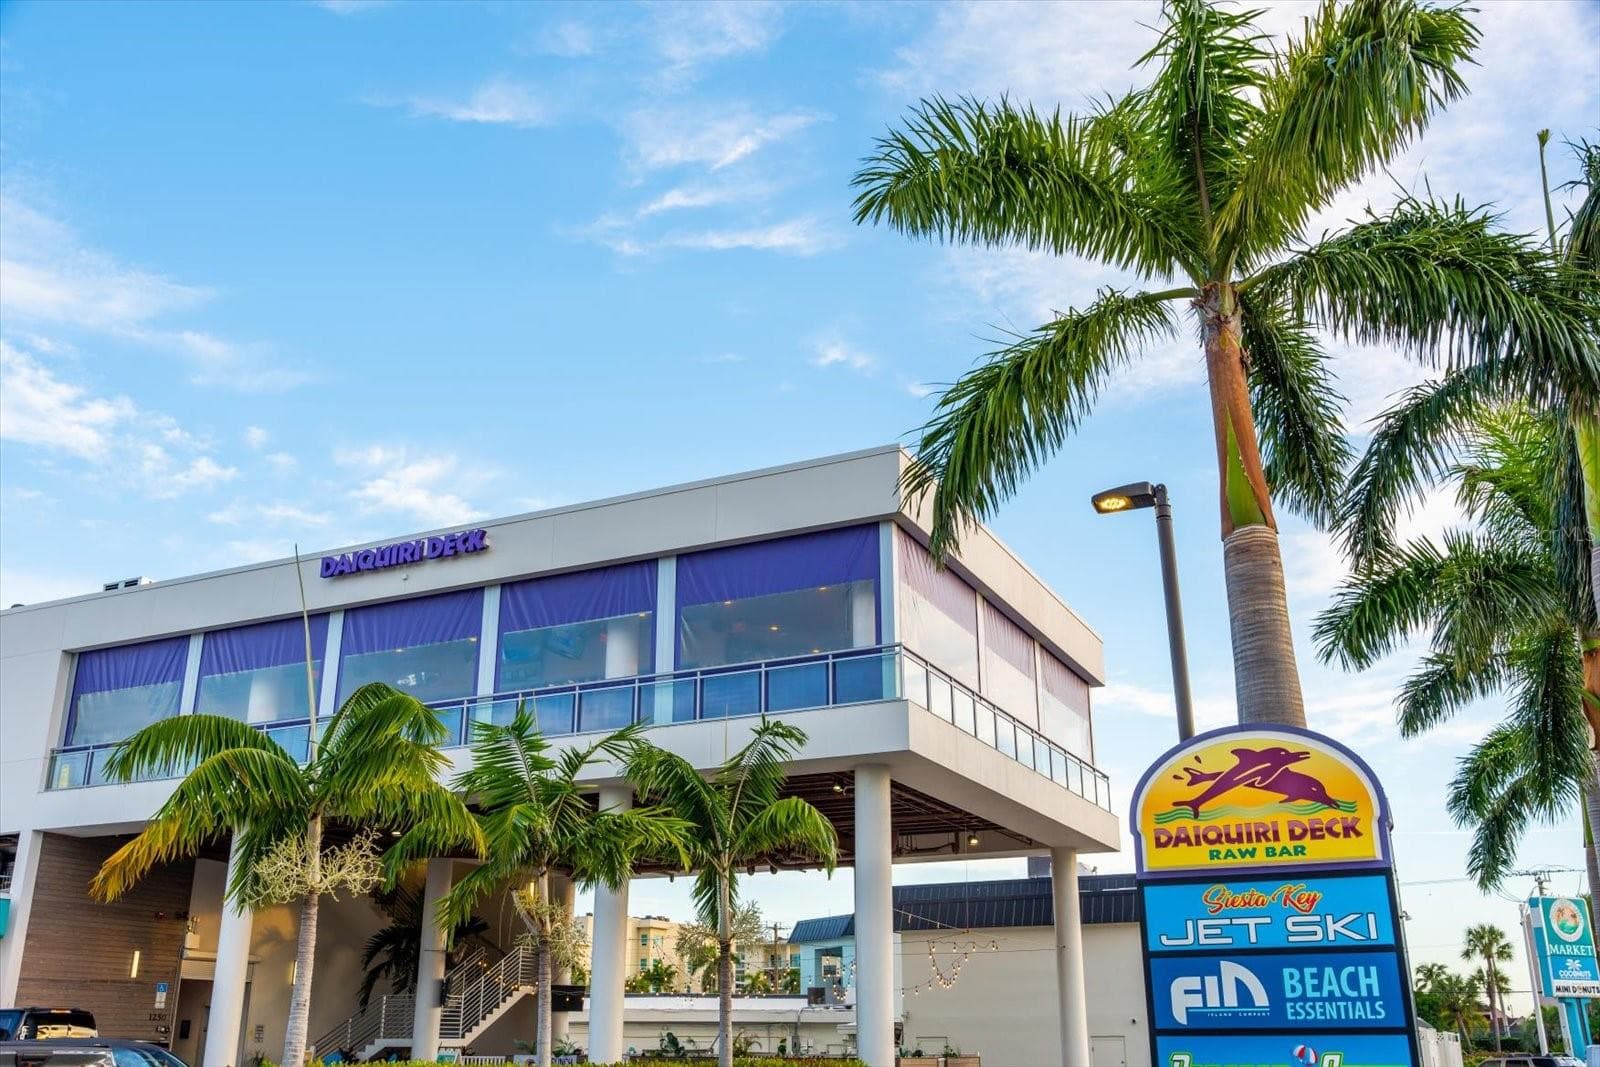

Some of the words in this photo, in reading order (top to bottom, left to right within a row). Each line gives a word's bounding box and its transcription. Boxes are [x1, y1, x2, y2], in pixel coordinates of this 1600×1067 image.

[320, 539, 425, 578] DAIQUIRI
[427, 528, 489, 560] DECK
[1154, 820, 1281, 849] DAIQUIRI
[1288, 816, 1363, 842] DECK
[1208, 847, 1257, 861] RAW
[1265, 845, 1307, 858] BAR
[1203, 884, 1268, 914] Siesta
[1270, 884, 1321, 914] Key
[1160, 915, 1271, 947] JET
[1284, 913, 1378, 944] SKI
[1550, 944, 1592, 956] MARKET
[1282, 966, 1379, 999] BEACH
[1286, 1000, 1385, 1020] ESSENTIALS
